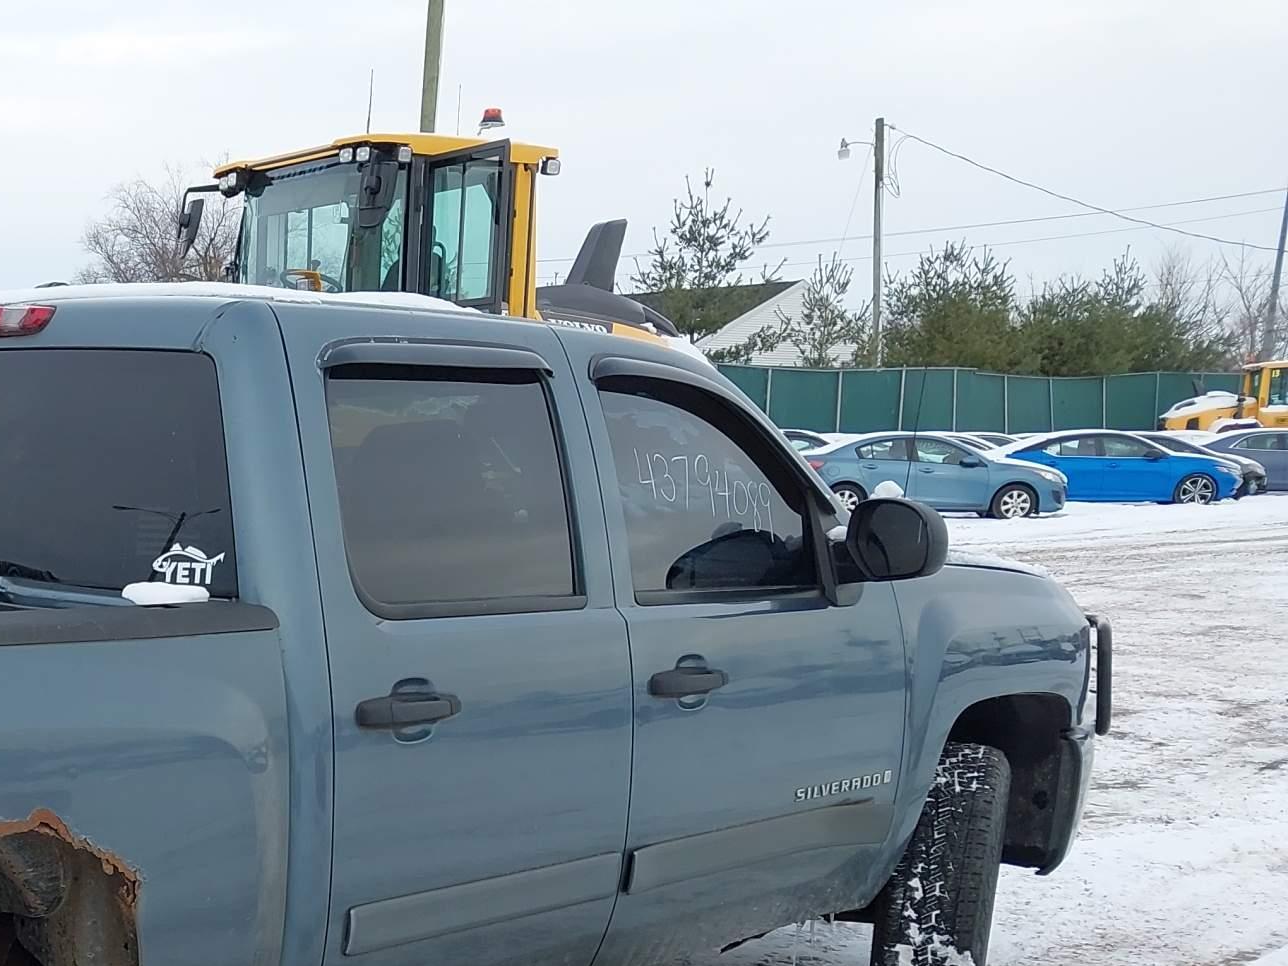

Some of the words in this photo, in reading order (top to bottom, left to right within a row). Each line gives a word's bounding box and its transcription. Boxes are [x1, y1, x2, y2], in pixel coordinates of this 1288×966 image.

[633, 448, 775, 543] 43794089
[164, 561, 212, 585] YETI
[794, 773, 881, 802] SILVERADO
